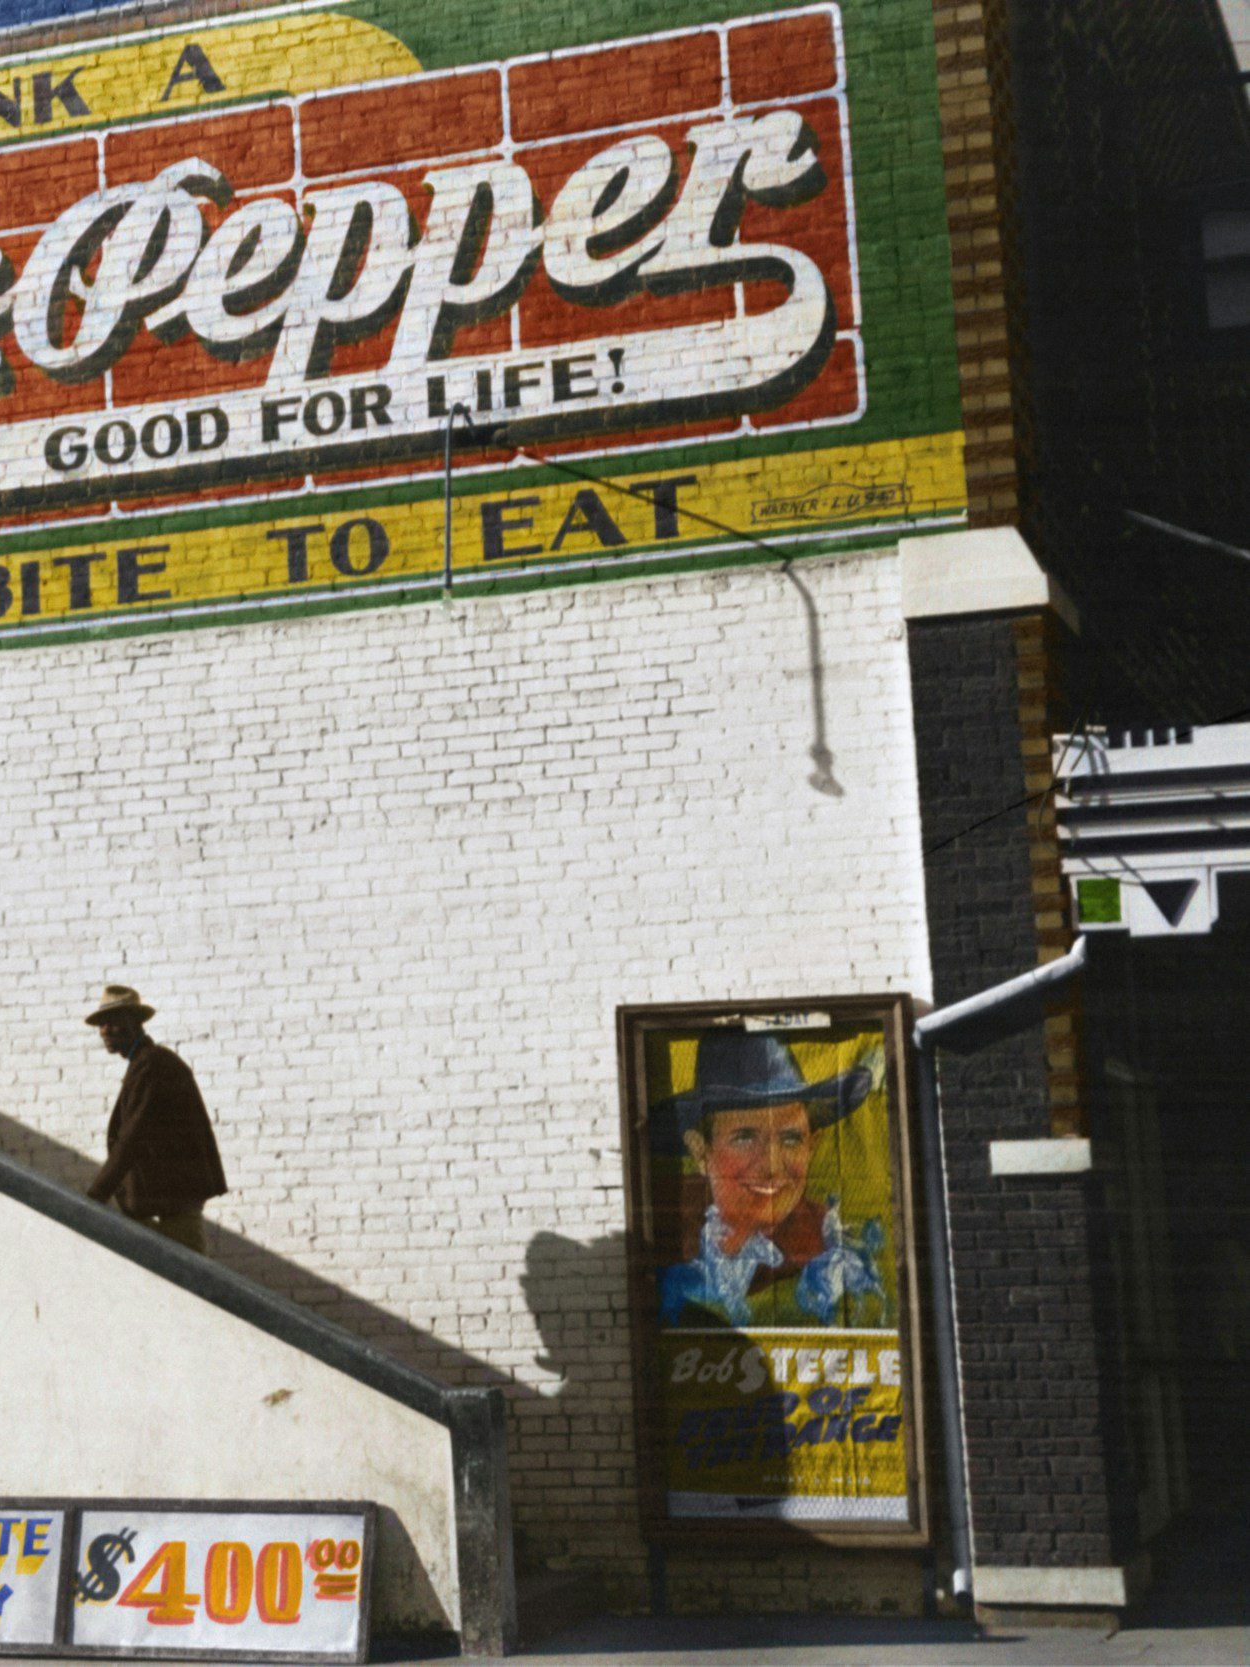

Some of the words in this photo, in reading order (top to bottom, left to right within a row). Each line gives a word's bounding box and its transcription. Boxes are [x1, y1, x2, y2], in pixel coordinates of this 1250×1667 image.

[161, 43, 226, 102] A
[13, 110, 827, 395] Pepper
[44, 405, 230, 471] GOOD
[260, 384, 393, 443] FOR
[426, 347, 625, 418] LIFE!
[266, 517, 391, 583] TO
[480, 474, 698, 561] EAT
[759, 498, 818, 517] WARNER
[670, 1347, 737, 1384] Bob
[735, 1346, 901, 1394] STEELE
[807, 1385, 872, 1416] OF
[760, 1414, 901, 1462] RANGE
